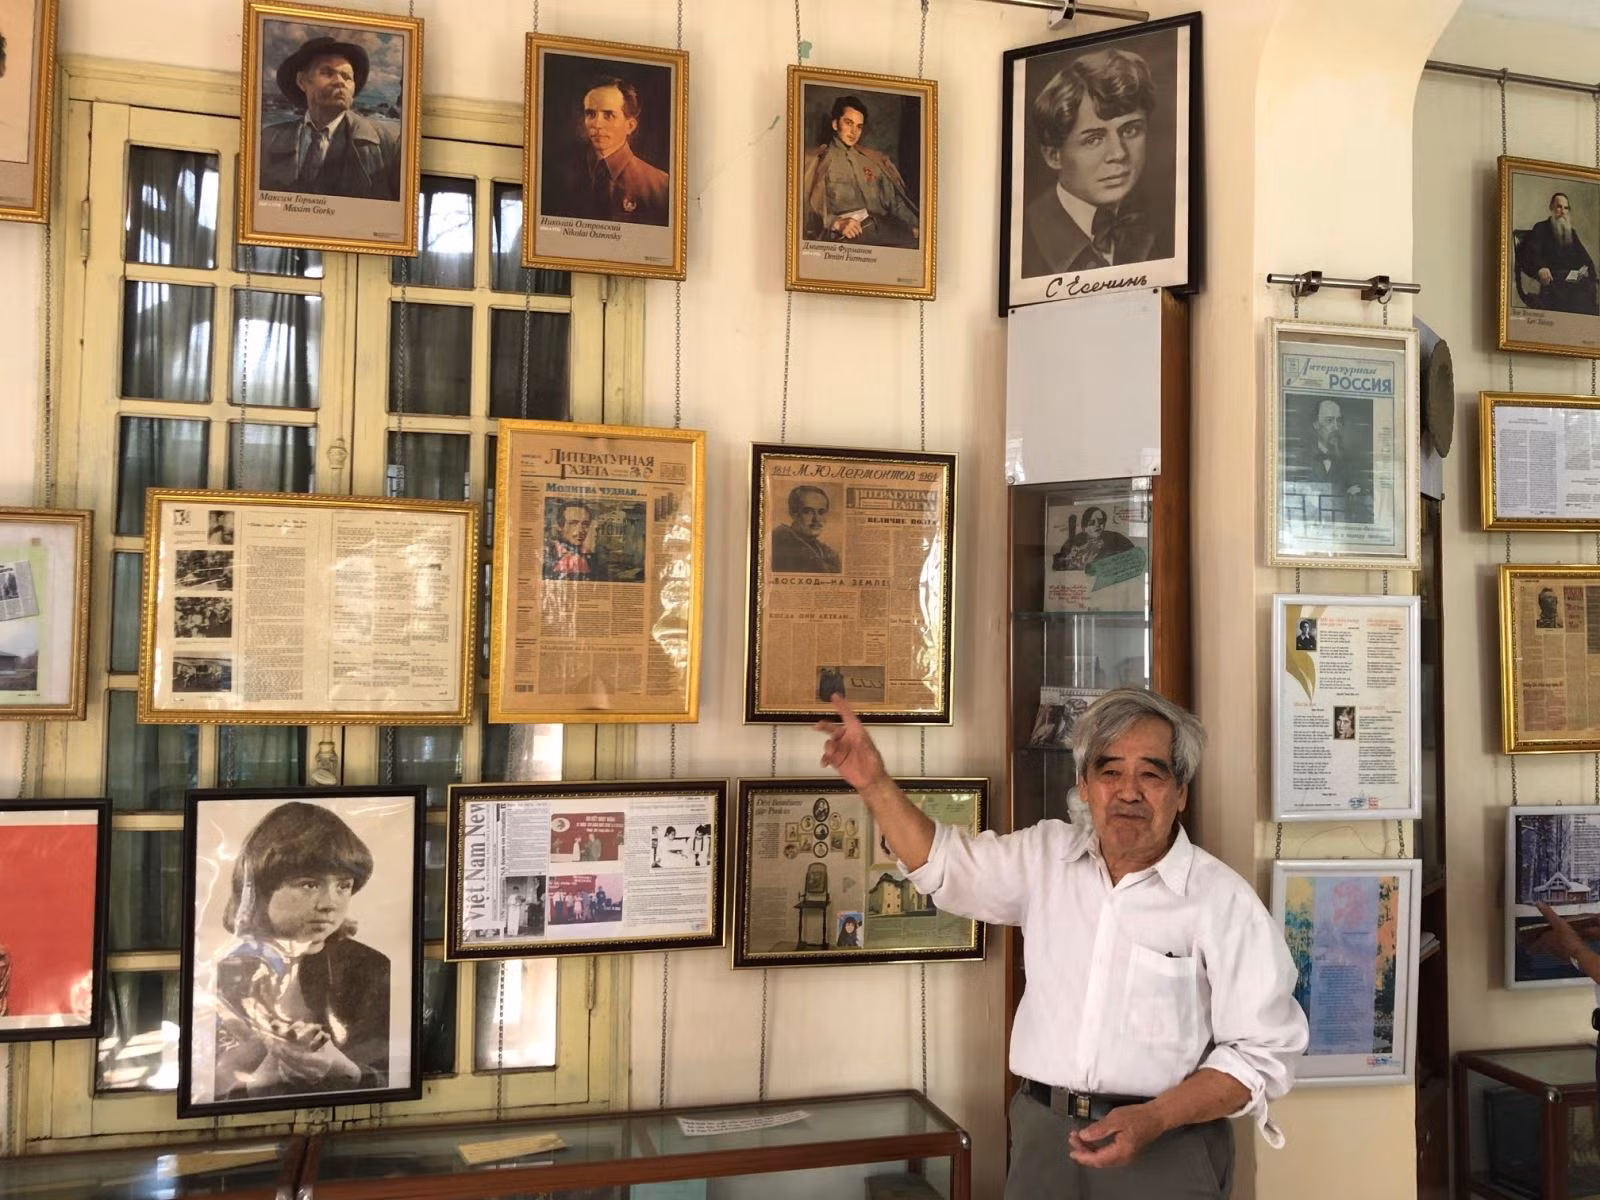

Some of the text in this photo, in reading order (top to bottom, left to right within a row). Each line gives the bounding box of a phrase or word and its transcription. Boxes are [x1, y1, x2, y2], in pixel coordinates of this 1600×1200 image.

[283, 203, 311, 213] Maxim
[312, 206, 336, 216] Gorky
[1329, 373, 1392, 392] РОССИЯ
[545, 448, 655, 467] ЛИТЕРАТУРНАЯ
[560, 463, 609, 480] ГАЗЕТА
[465, 842, 486, 881] Nam
